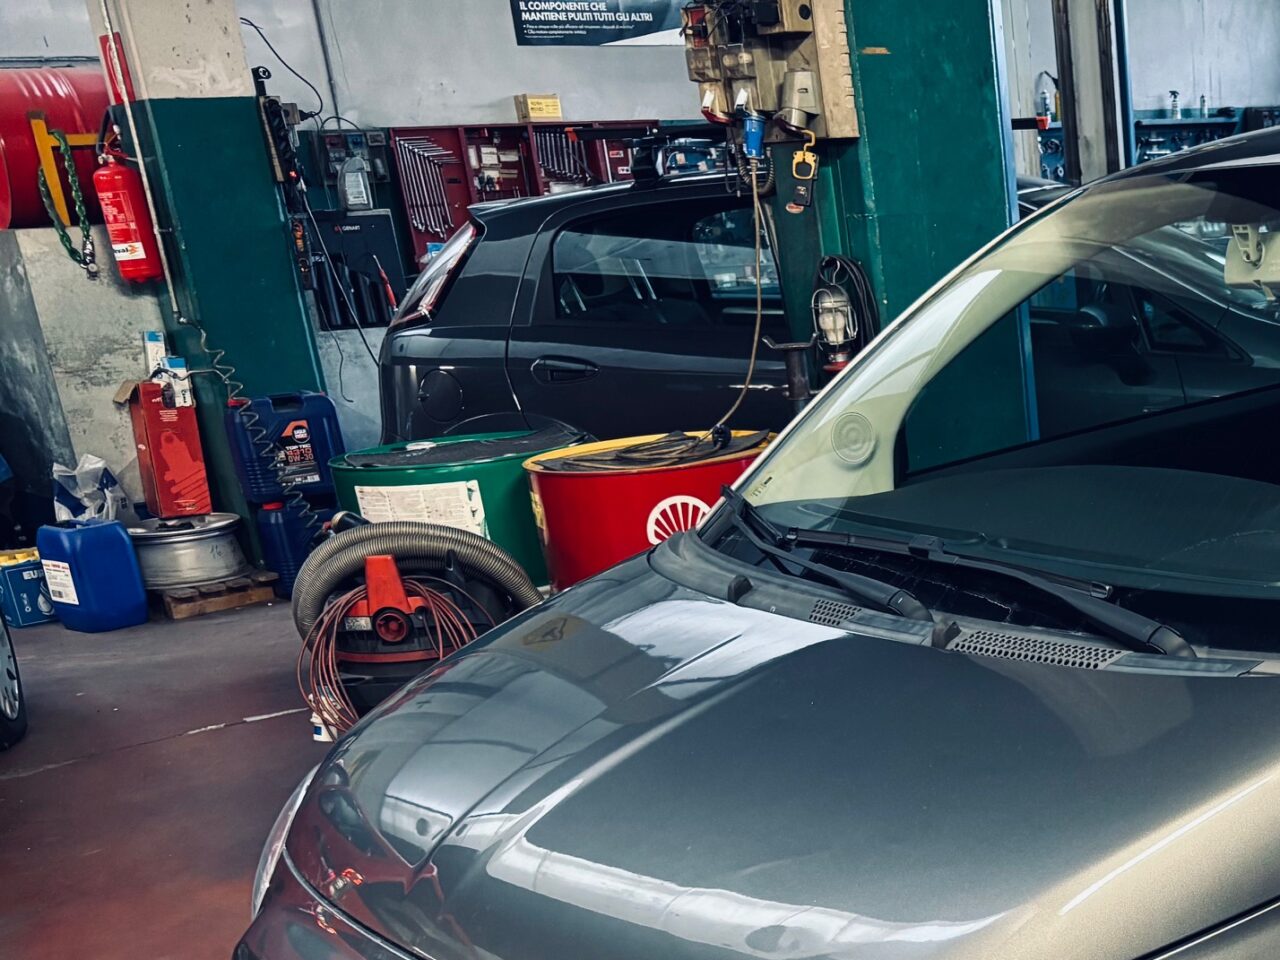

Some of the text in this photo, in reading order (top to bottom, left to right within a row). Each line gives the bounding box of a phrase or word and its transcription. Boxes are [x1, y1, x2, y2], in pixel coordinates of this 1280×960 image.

[519, 1, 607, 11] IL COMPONENTE CHE
[521, 12, 653, 22] MANTIENE PULITI TUTTI GLI ALTRI
